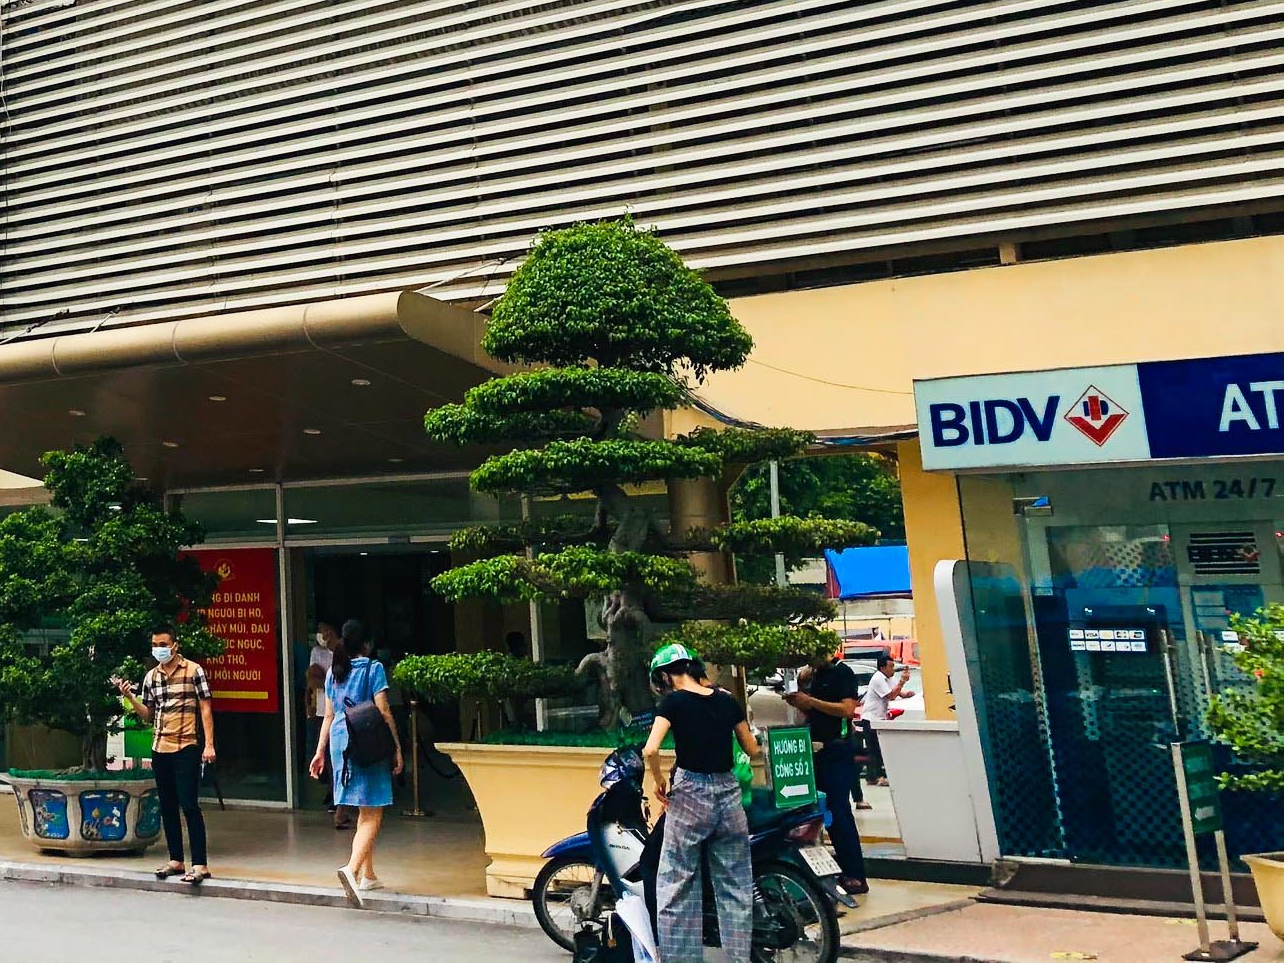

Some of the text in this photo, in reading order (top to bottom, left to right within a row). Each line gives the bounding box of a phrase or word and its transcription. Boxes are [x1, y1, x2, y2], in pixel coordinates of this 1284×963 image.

[929, 395, 1061, 448] BIDV
[1149, 477, 1277, 502] ATM 24/7
[805, 760, 809, 776] 2
